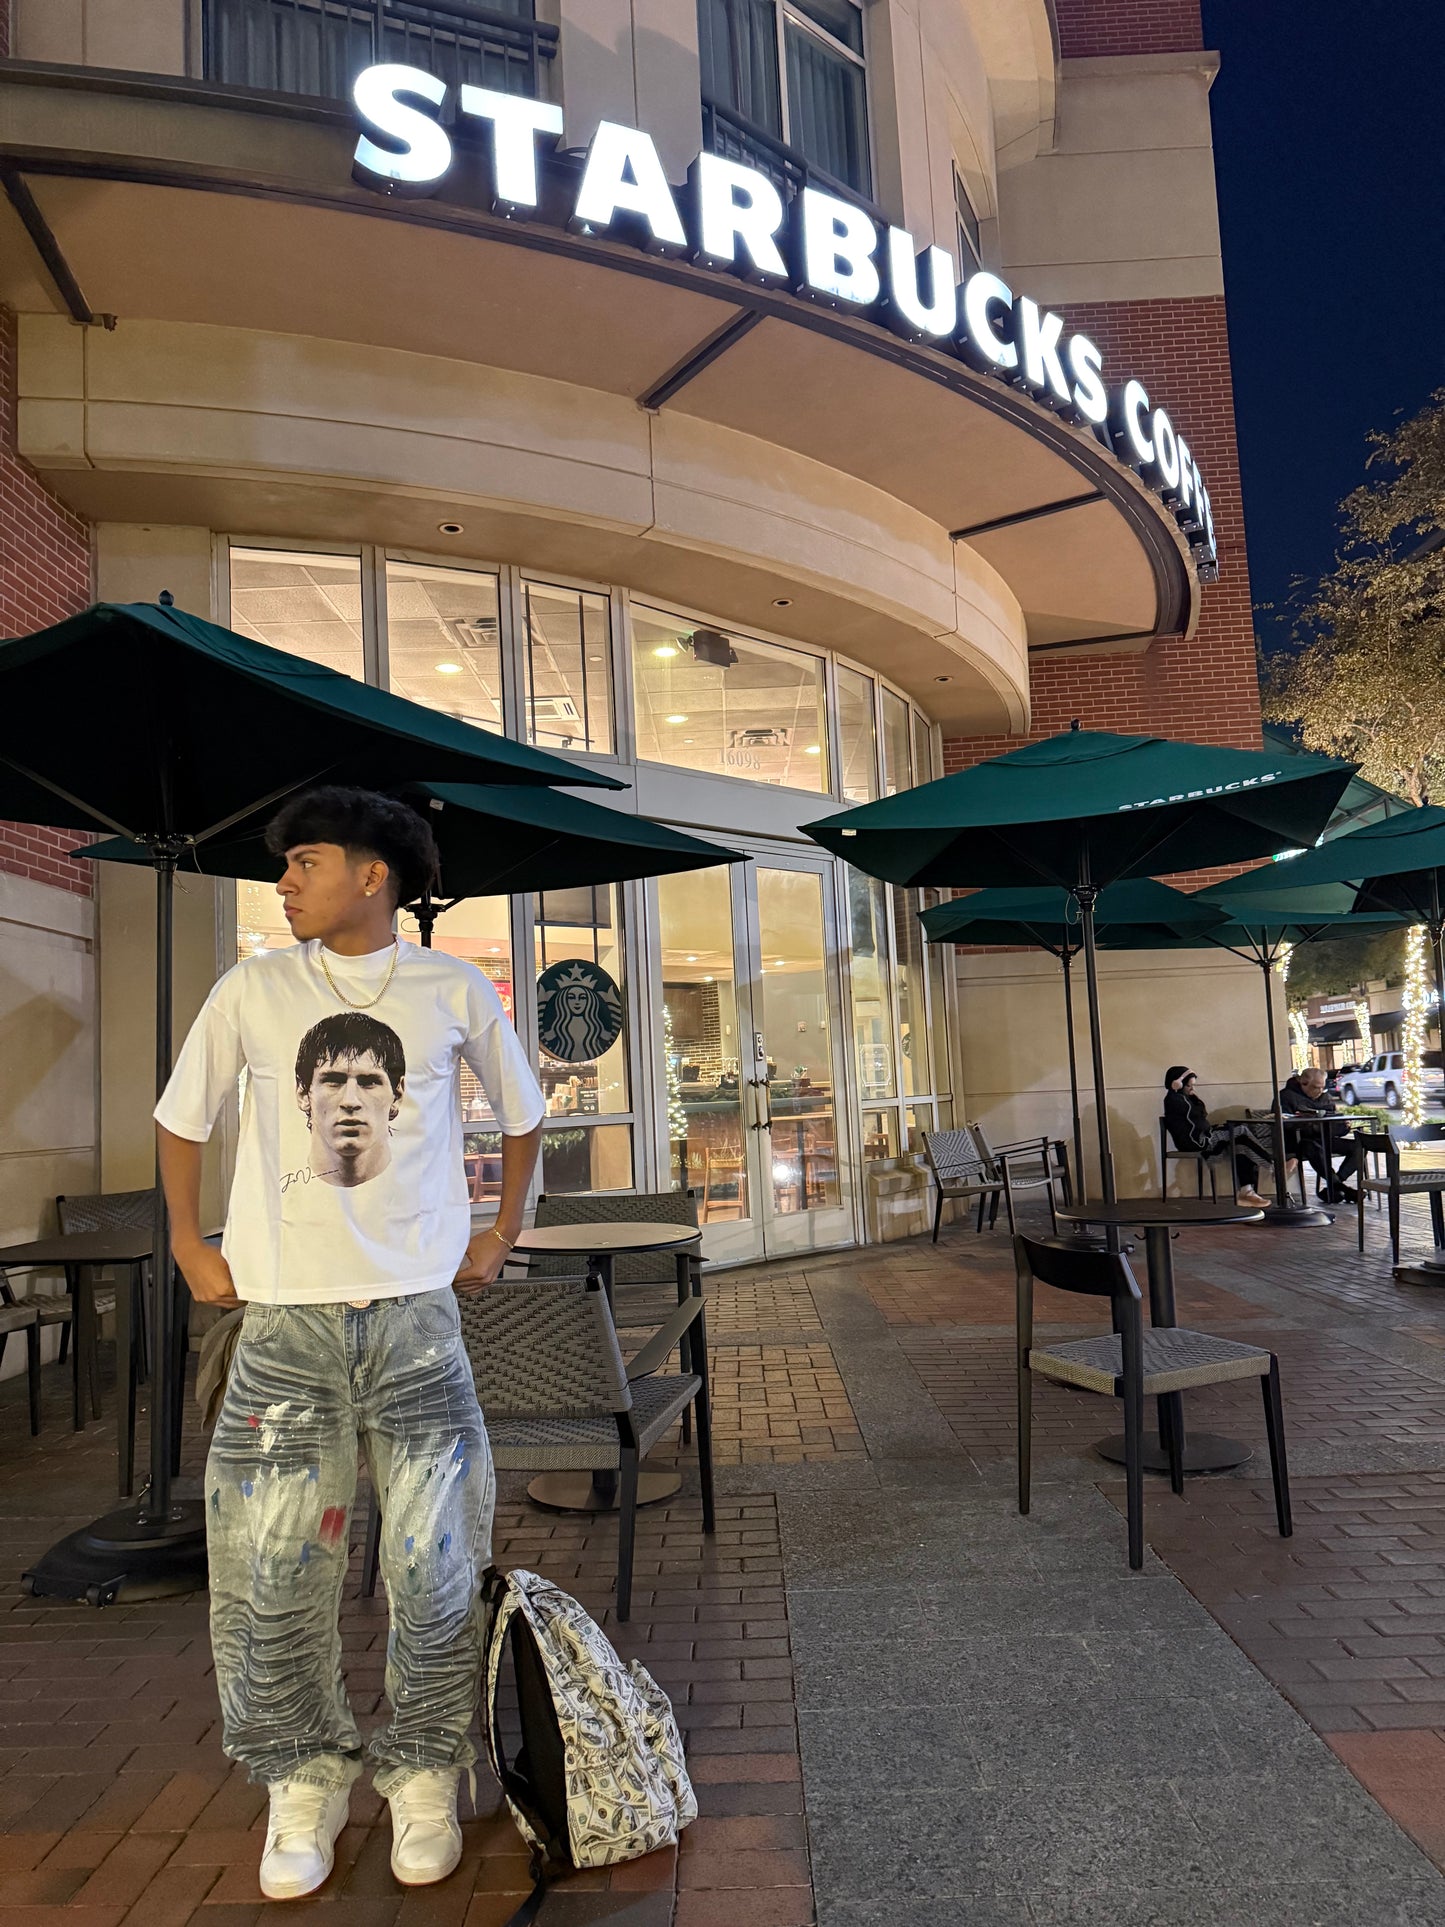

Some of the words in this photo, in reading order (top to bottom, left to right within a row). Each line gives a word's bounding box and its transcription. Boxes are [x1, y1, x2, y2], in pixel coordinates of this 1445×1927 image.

[353, 63, 1109, 425] STARBUCKS
[1124, 379, 1219, 583] COFFE
[719, 748, 761, 771] 16098
[1118, 772, 1278, 810] STARBUCKS
